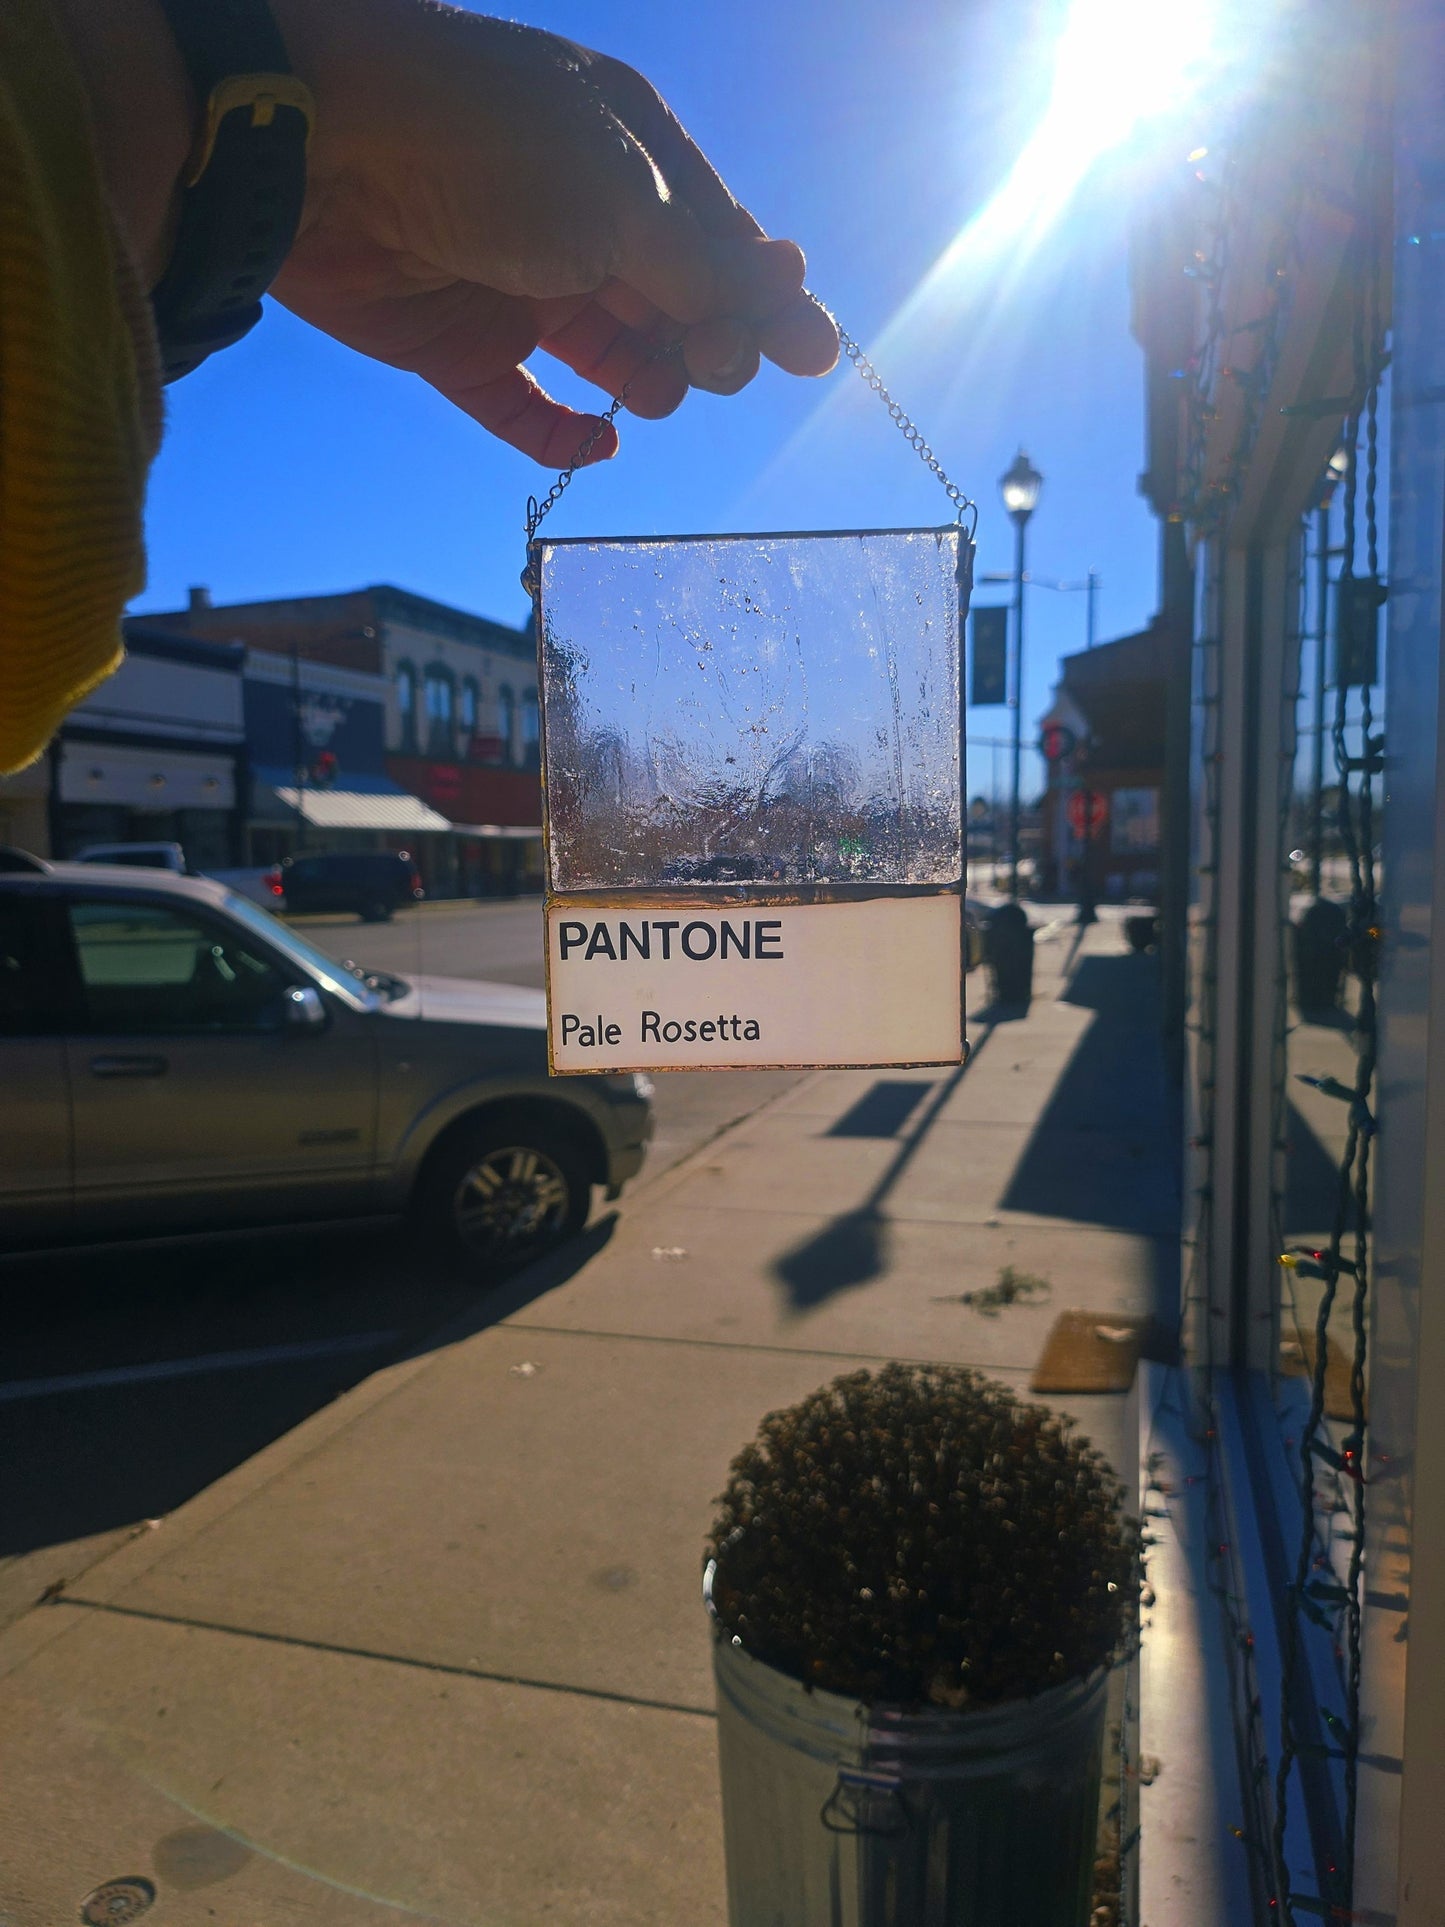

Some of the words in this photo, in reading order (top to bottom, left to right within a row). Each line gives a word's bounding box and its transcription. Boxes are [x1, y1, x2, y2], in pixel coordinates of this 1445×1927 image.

[559, 920, 784, 961] PANTONE
[561, 1014, 622, 1047] Pale
[641, 1010, 761, 1043] Rosetta
